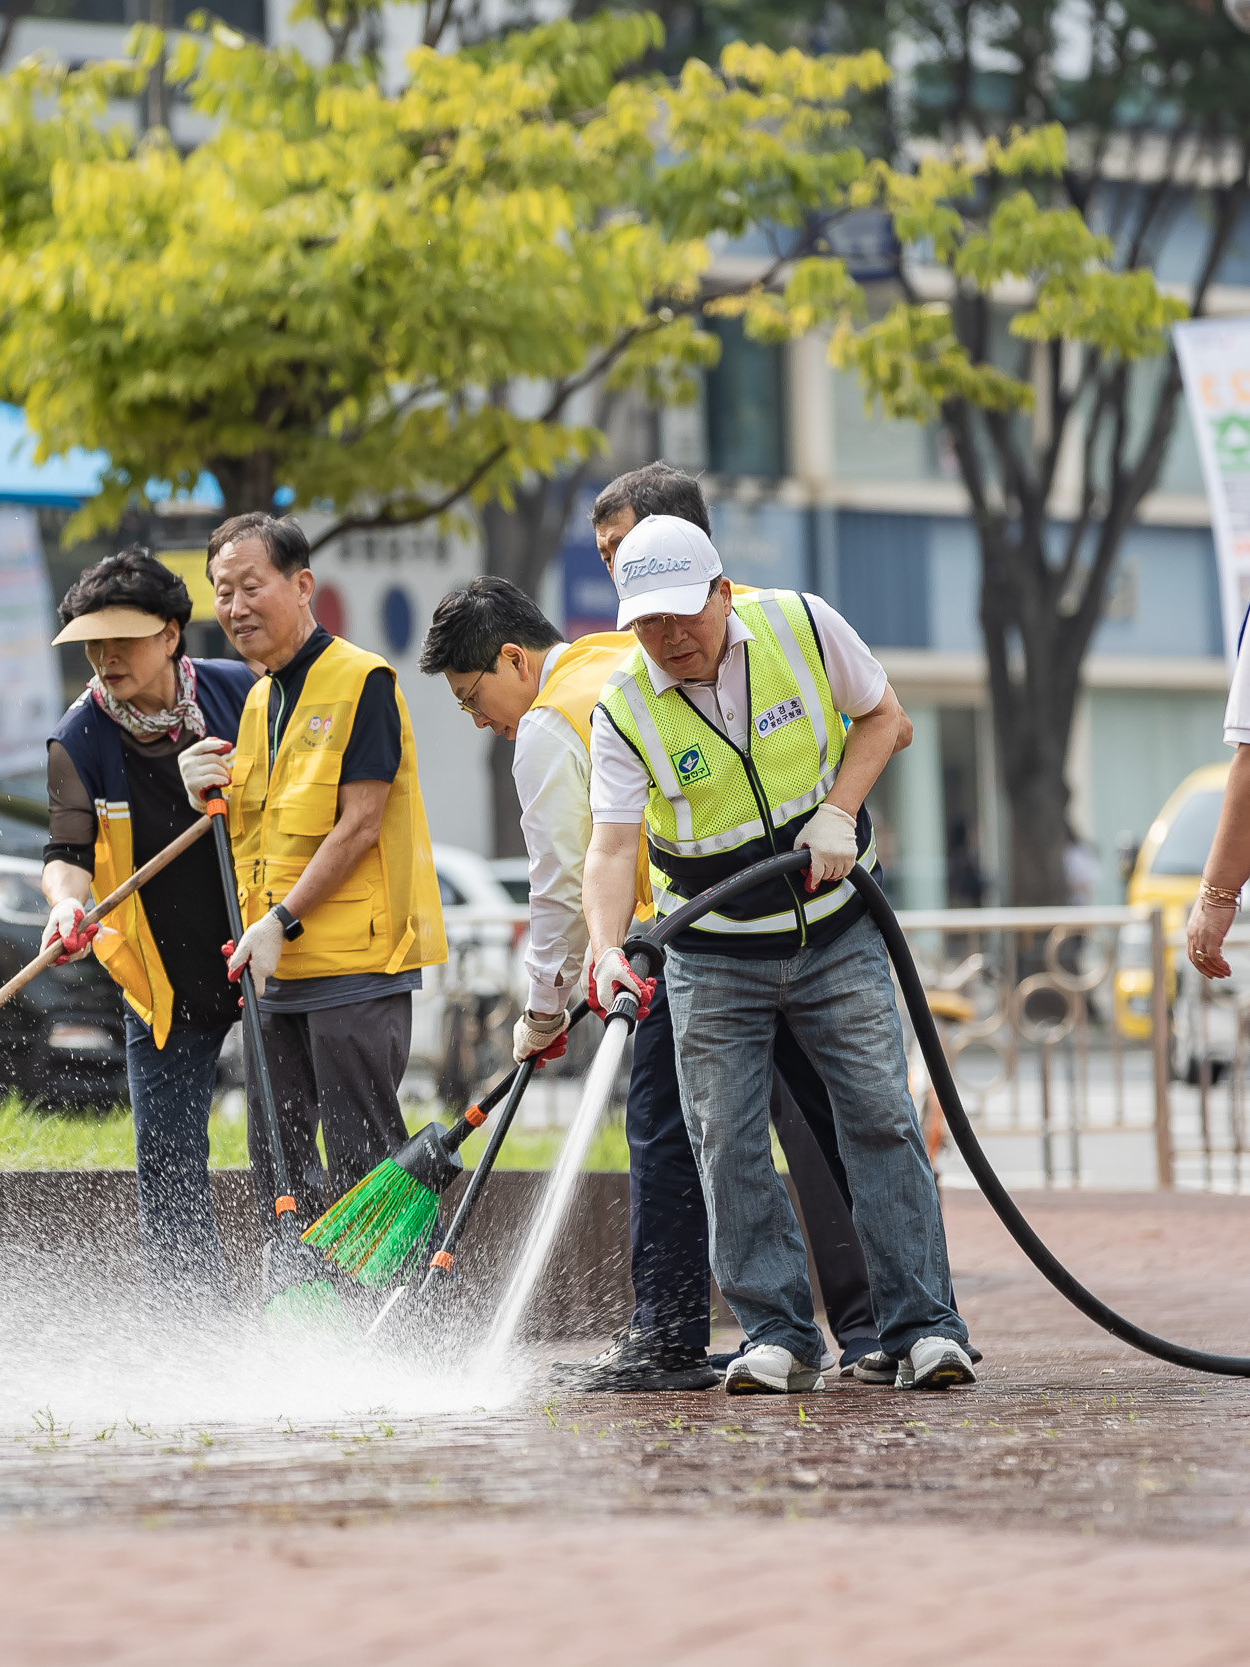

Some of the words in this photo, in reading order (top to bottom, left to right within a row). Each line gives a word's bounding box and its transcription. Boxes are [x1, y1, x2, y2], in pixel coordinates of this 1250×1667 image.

[620, 555, 692, 586] Titleist
[770, 708, 802, 728] 광진구청장
[682, 767, 705, 781] 광진구
